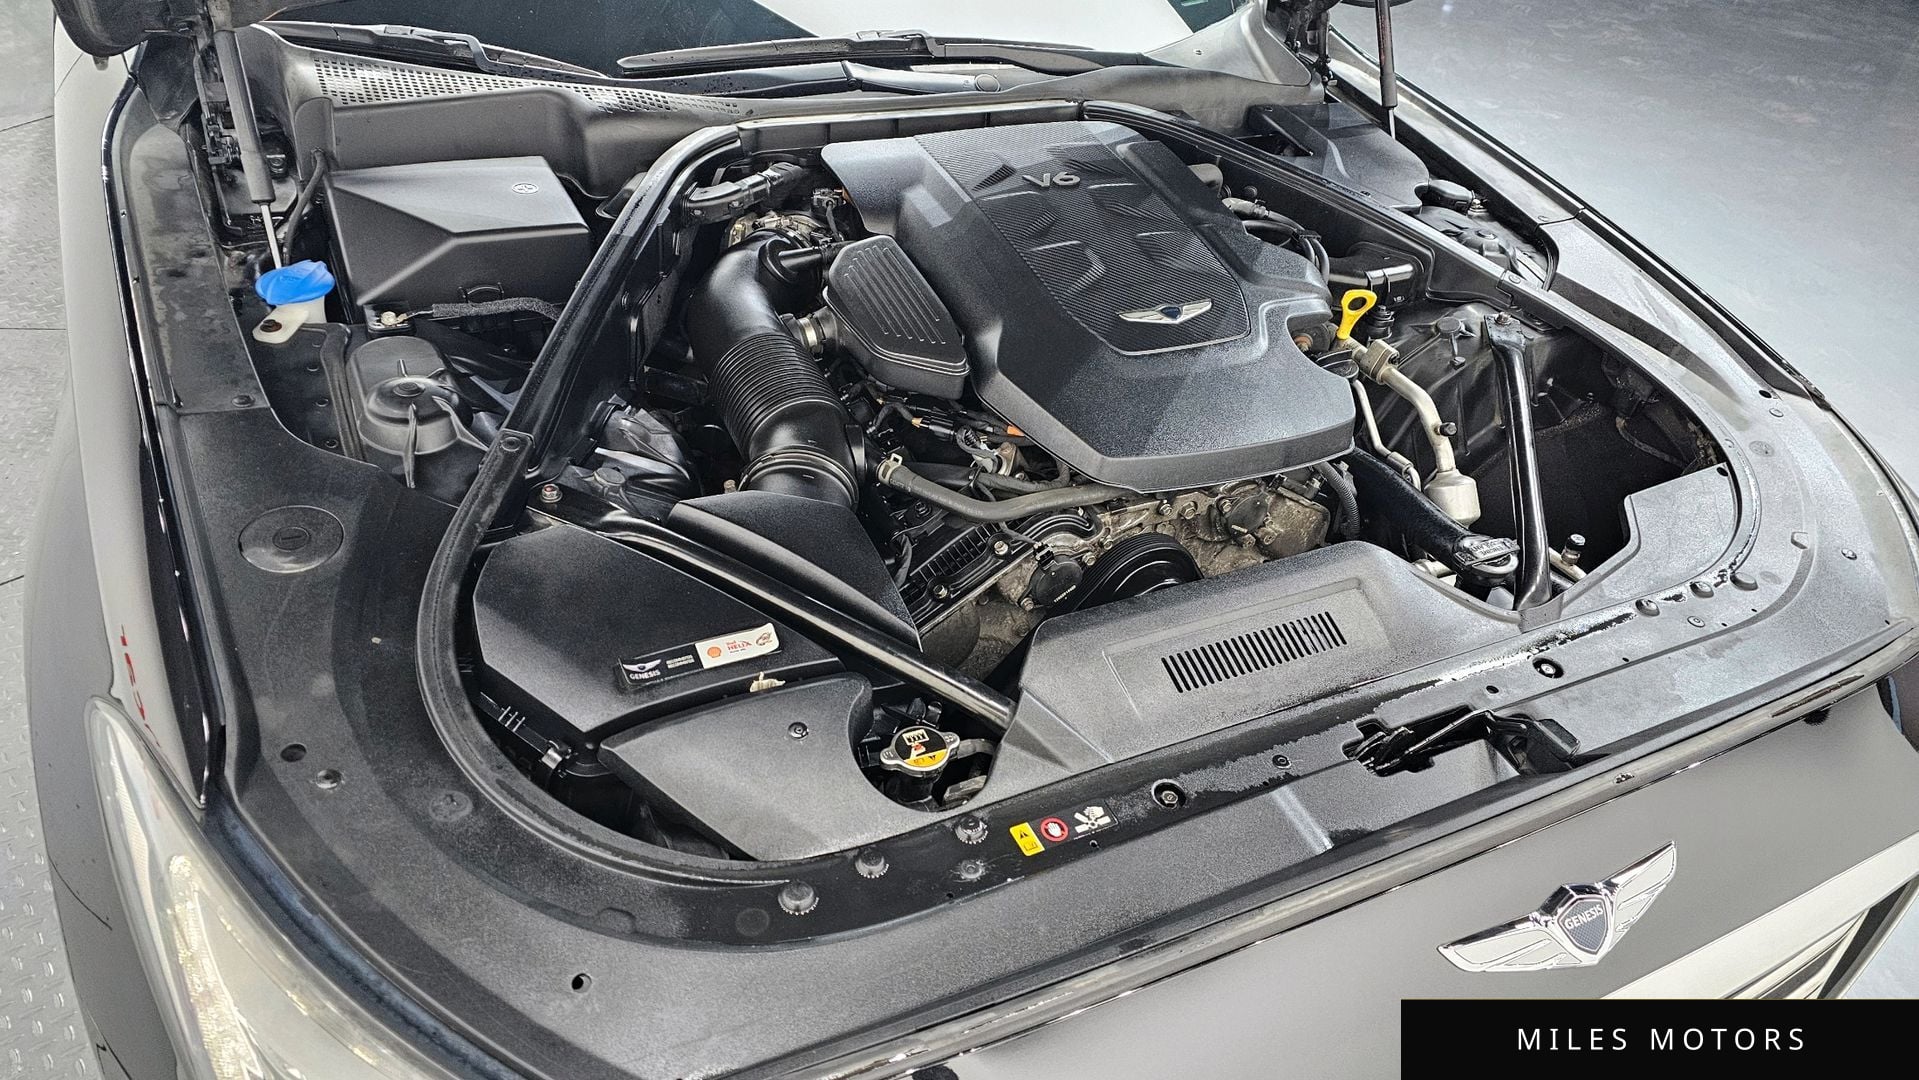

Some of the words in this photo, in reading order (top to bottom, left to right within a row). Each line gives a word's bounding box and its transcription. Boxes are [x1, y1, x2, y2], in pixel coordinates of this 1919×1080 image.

[1021, 171, 1081, 187] V6
[629, 669, 661, 680] GENESIS
[1564, 904, 1604, 930] GENESIS
